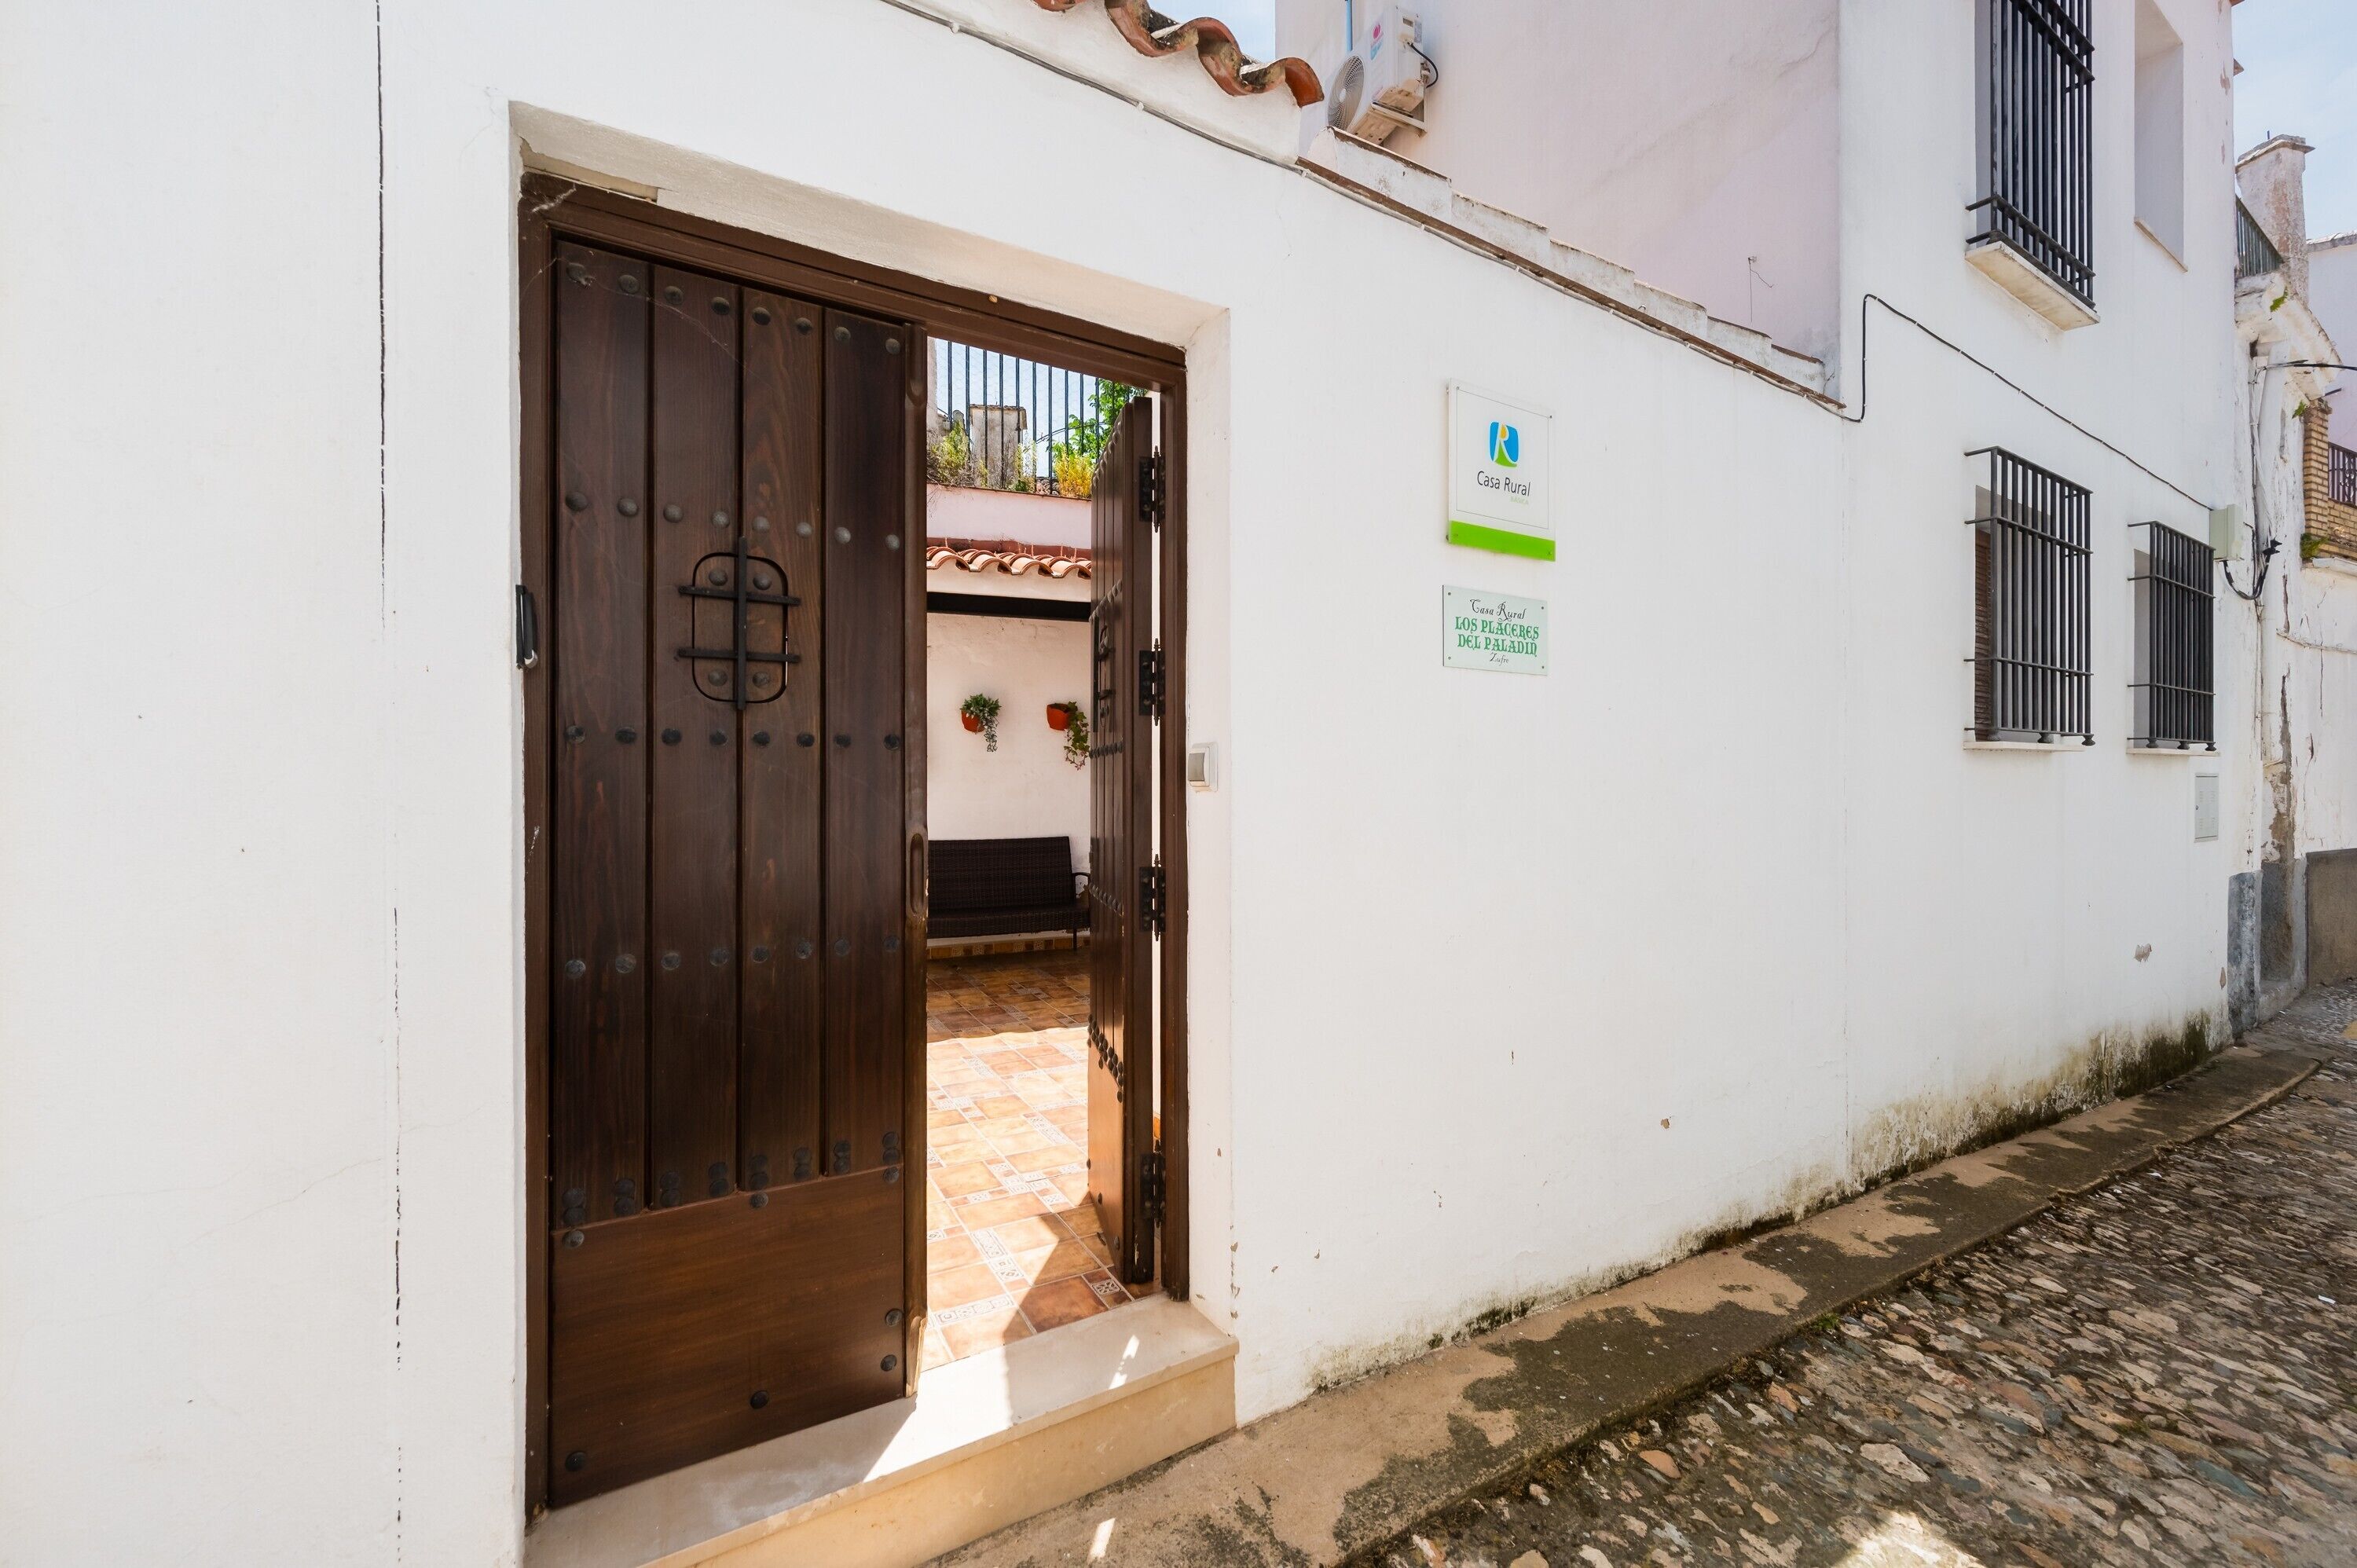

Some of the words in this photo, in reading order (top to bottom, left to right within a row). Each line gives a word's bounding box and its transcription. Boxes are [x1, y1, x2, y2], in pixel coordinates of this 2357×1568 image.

[1477, 471, 1501, 489] Casa
[1504, 477, 1530, 496] Rural
[1469, 599, 1494, 615] Casa
[1497, 601, 1527, 622] Rural
[1455, 616, 1477, 634] LOS
[1480, 620, 1539, 641] PLACERES
[1457, 633, 1481, 650] DEL
[1484, 636, 1538, 657] PALADIN
[1489, 653, 1509, 666] Zufre
